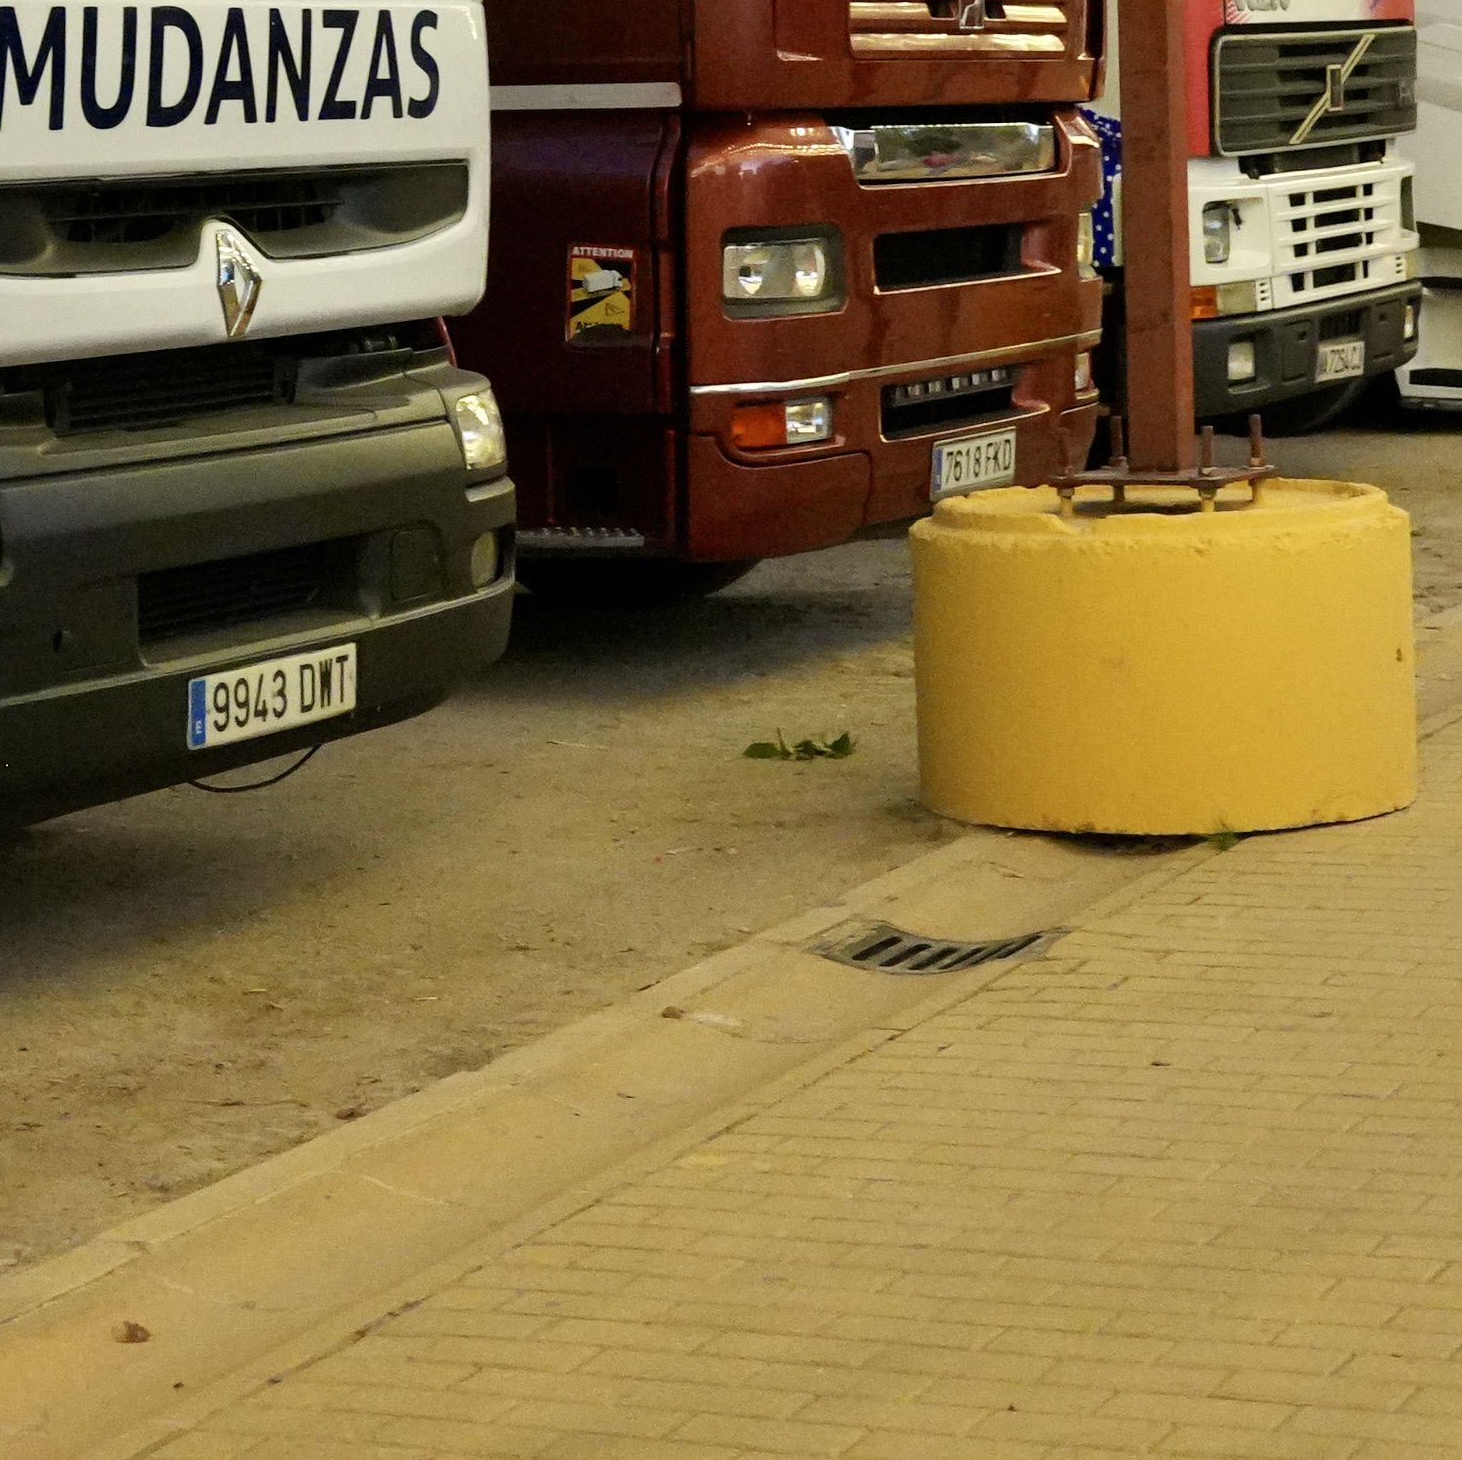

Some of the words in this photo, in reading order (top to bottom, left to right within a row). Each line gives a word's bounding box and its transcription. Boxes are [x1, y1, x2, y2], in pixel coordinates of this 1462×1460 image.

[572, 246, 634, 258] ATTENTION
[945, 445, 982, 486] 7618
[213, 669, 288, 733] 9943
[299, 654, 350, 714] DWT
